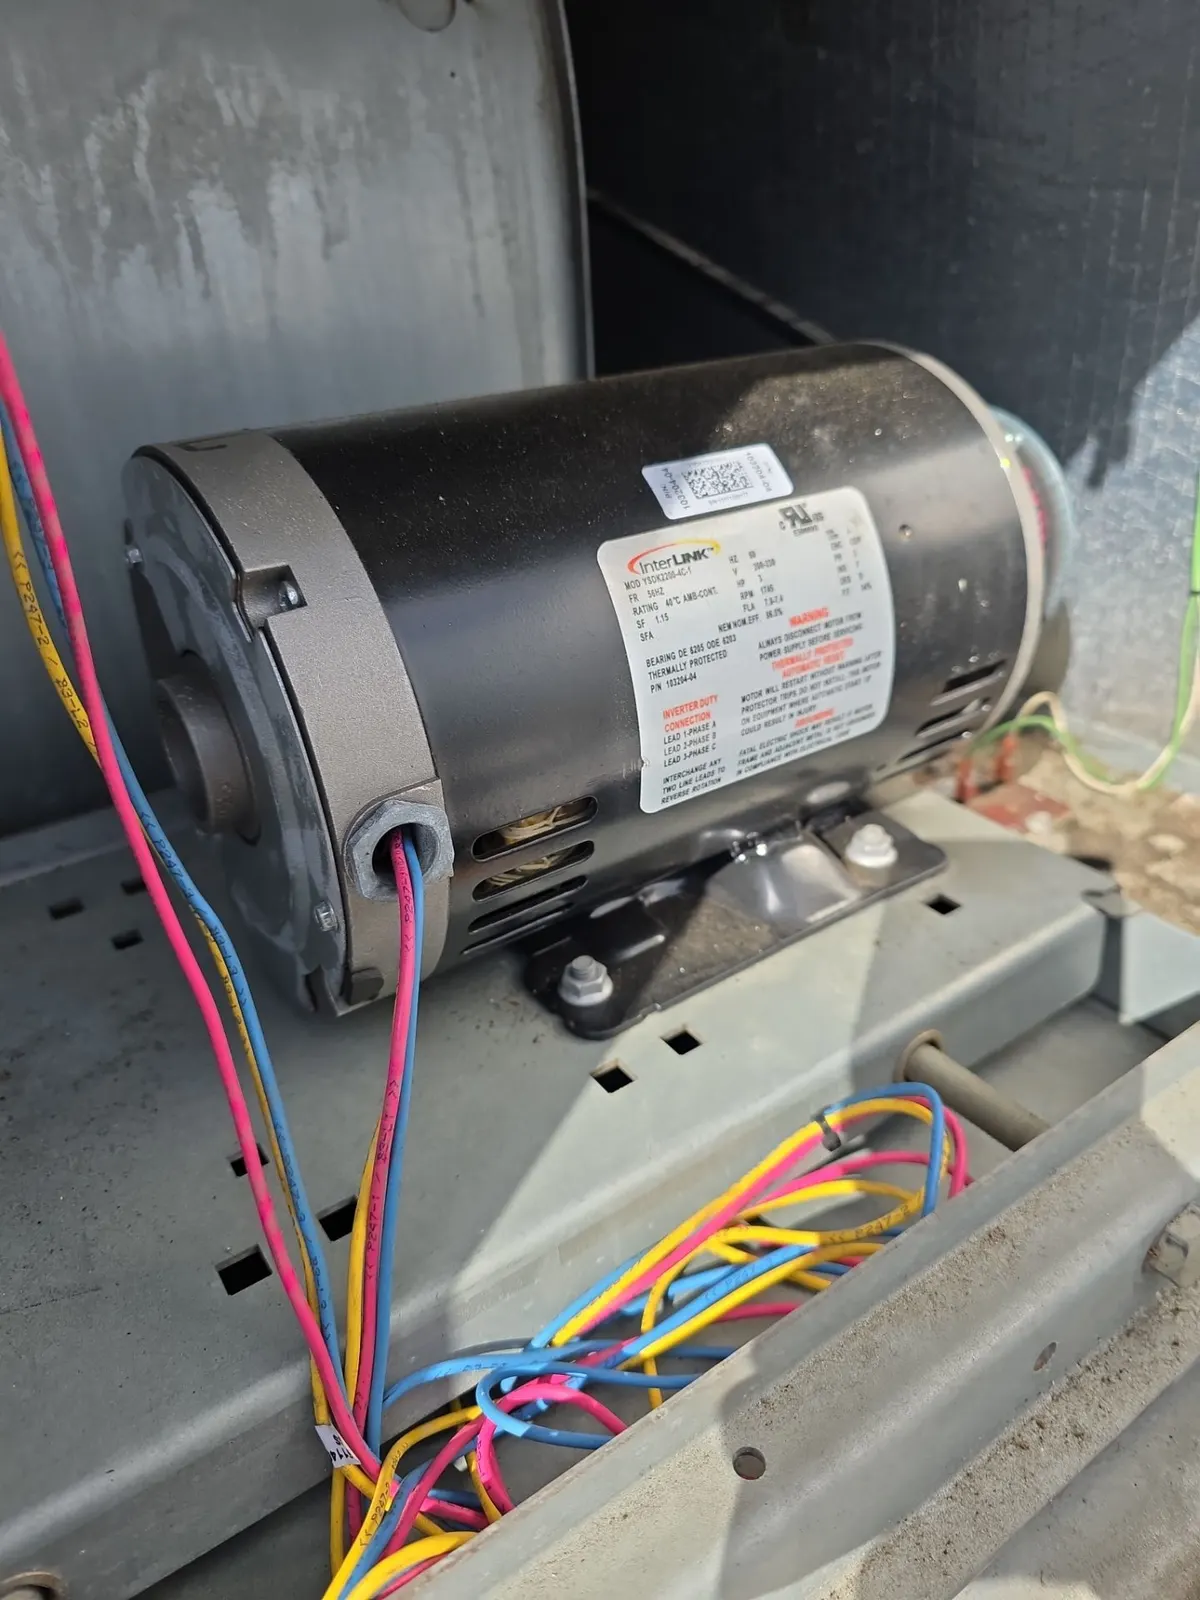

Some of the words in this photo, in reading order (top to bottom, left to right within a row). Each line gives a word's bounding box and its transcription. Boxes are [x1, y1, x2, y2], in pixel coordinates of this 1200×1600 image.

[729, 555, 738, 563] HZ
[624, 580, 640, 590] MOD
[740, 590, 754, 600] RPM
[629, 594, 639, 603] FR
[633, 602, 658, 616] RATING
[743, 603, 755, 612] FLA
[20, 582, 49, 645] P247-2
[637, 620, 645, 628] SF
[656, 613, 669, 624] 1.15
[640, 631, 654, 641] SFA
[758, 636, 782, 649] ALWAYS
[784, 624, 820, 641] DISCONNECT
[824, 618, 843, 628] MOTOR
[846, 612, 861, 621] FROM
[646, 652, 676, 667] BEARING
[678, 648, 687, 657] DE
[707, 639, 720, 649] ODE
[760, 648, 780, 661] POWER
[784, 641, 805, 654] SUPPLY
[808, 633, 830, 646] BEFORE
[648, 662, 687, 680] THERMALLY
[690, 650, 727, 668] PROTECTED
[651, 683, 662, 693] P/N
[666, 672, 696, 688] 103204-04
[741, 690, 762, 702] MOTOR
[766, 684, 779, 694] WILL
[782, 676, 807, 690] RESTART
[810, 666, 834, 679] WITHOUT
[663, 701, 698, 719] INVERTER
[700, 695, 718, 708] DUTY
[741, 717, 750, 725] ON
[753, 704, 786, 721] EQUIPMENT
[789, 698, 809, 709] WHERE
[812, 685, 843, 700] AUTOMATIC
[742, 696, 777, 713] PROTECTOR
[780, 690, 796, 700] TRIPS
[800, 686, 807, 694] DO
[810, 682, 821, 690] NOT
[665, 711, 710, 732] CONNECTION
[741, 725, 761, 736] COULD
[764, 715, 786, 728] RESULT
[797, 705, 816, 716] INJURY
[664, 733, 680, 744] LEAD
[684, 725, 709, 738] 1-PHASE
[664, 745, 680, 756] LEAD
[684, 736, 709, 750] 2-PHASE
[739, 746, 756, 756] FATAL
[759, 735, 787, 749] ELECTRIC
[790, 728, 808, 738] SHOCK
[664, 756, 680, 767] LEAD
[684, 747, 709, 760] 3-PHASE
[738, 755, 758, 765] FRAME
[775, 738, 804, 753] ADJACENT
[745, 756, 781, 772] COMPLIANCE
[784, 749, 798, 757] WITH
[663, 763, 706, 784] INTERCHANGE
[710, 758, 722, 767] ANY
[663, 785, 676, 794] TWO
[679, 778, 692, 788] LINE
[696, 771, 715, 782] LEADS
[661, 789, 689, 804] REVERSE
[692, 777, 721, 792] ROTATION
